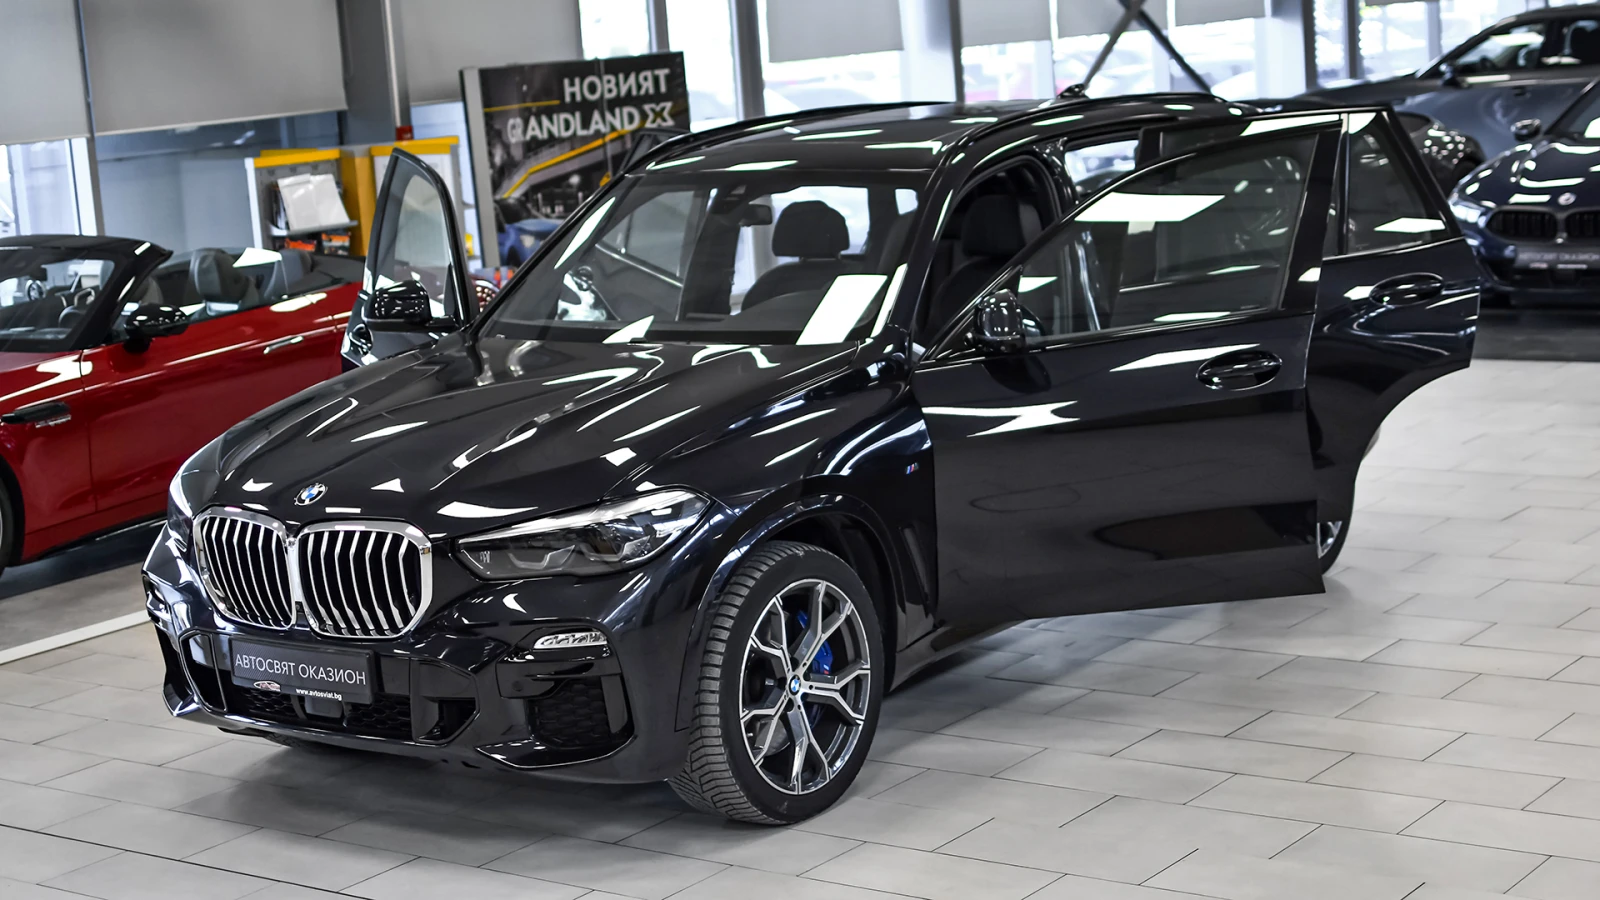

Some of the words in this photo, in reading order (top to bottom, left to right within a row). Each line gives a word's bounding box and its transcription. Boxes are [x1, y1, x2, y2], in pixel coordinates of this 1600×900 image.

[563, 68, 670, 103] НОВИЯТ
[235, 654, 295, 676] АВТОСВЯТ
[298, 663, 366, 685] ОКАЗИОН
